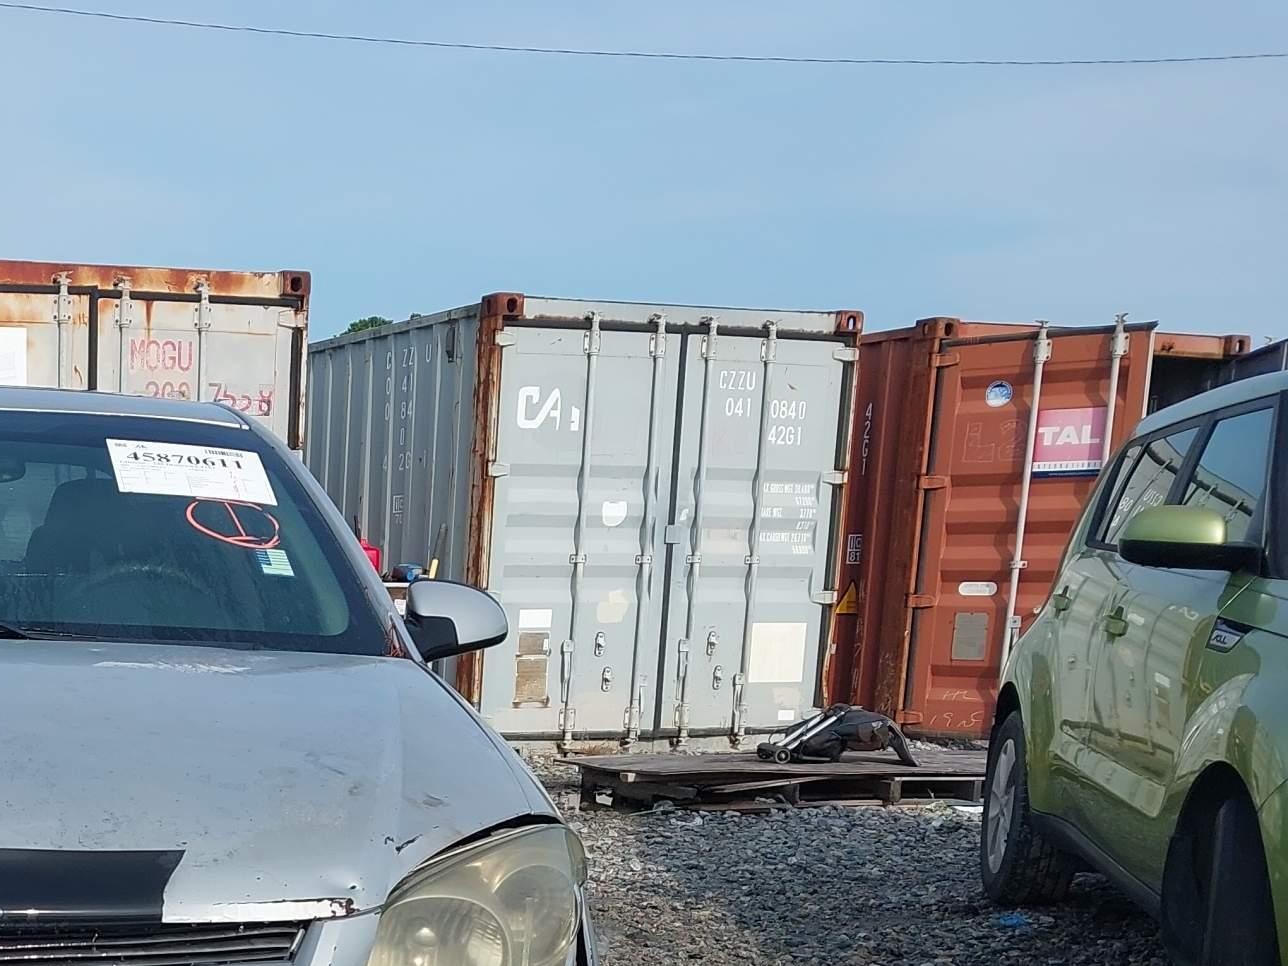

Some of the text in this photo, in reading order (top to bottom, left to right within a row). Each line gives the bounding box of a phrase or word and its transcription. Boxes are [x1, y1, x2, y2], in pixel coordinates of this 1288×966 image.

[130, 338, 193, 371] MOGU
[719, 370, 756, 390] CZZU
[725, 398, 807, 420] 041 0840
[767, 425, 802, 446] 42G1
[1038, 425, 1101, 446] TAL
[126, 451, 243, 470] 45870611
